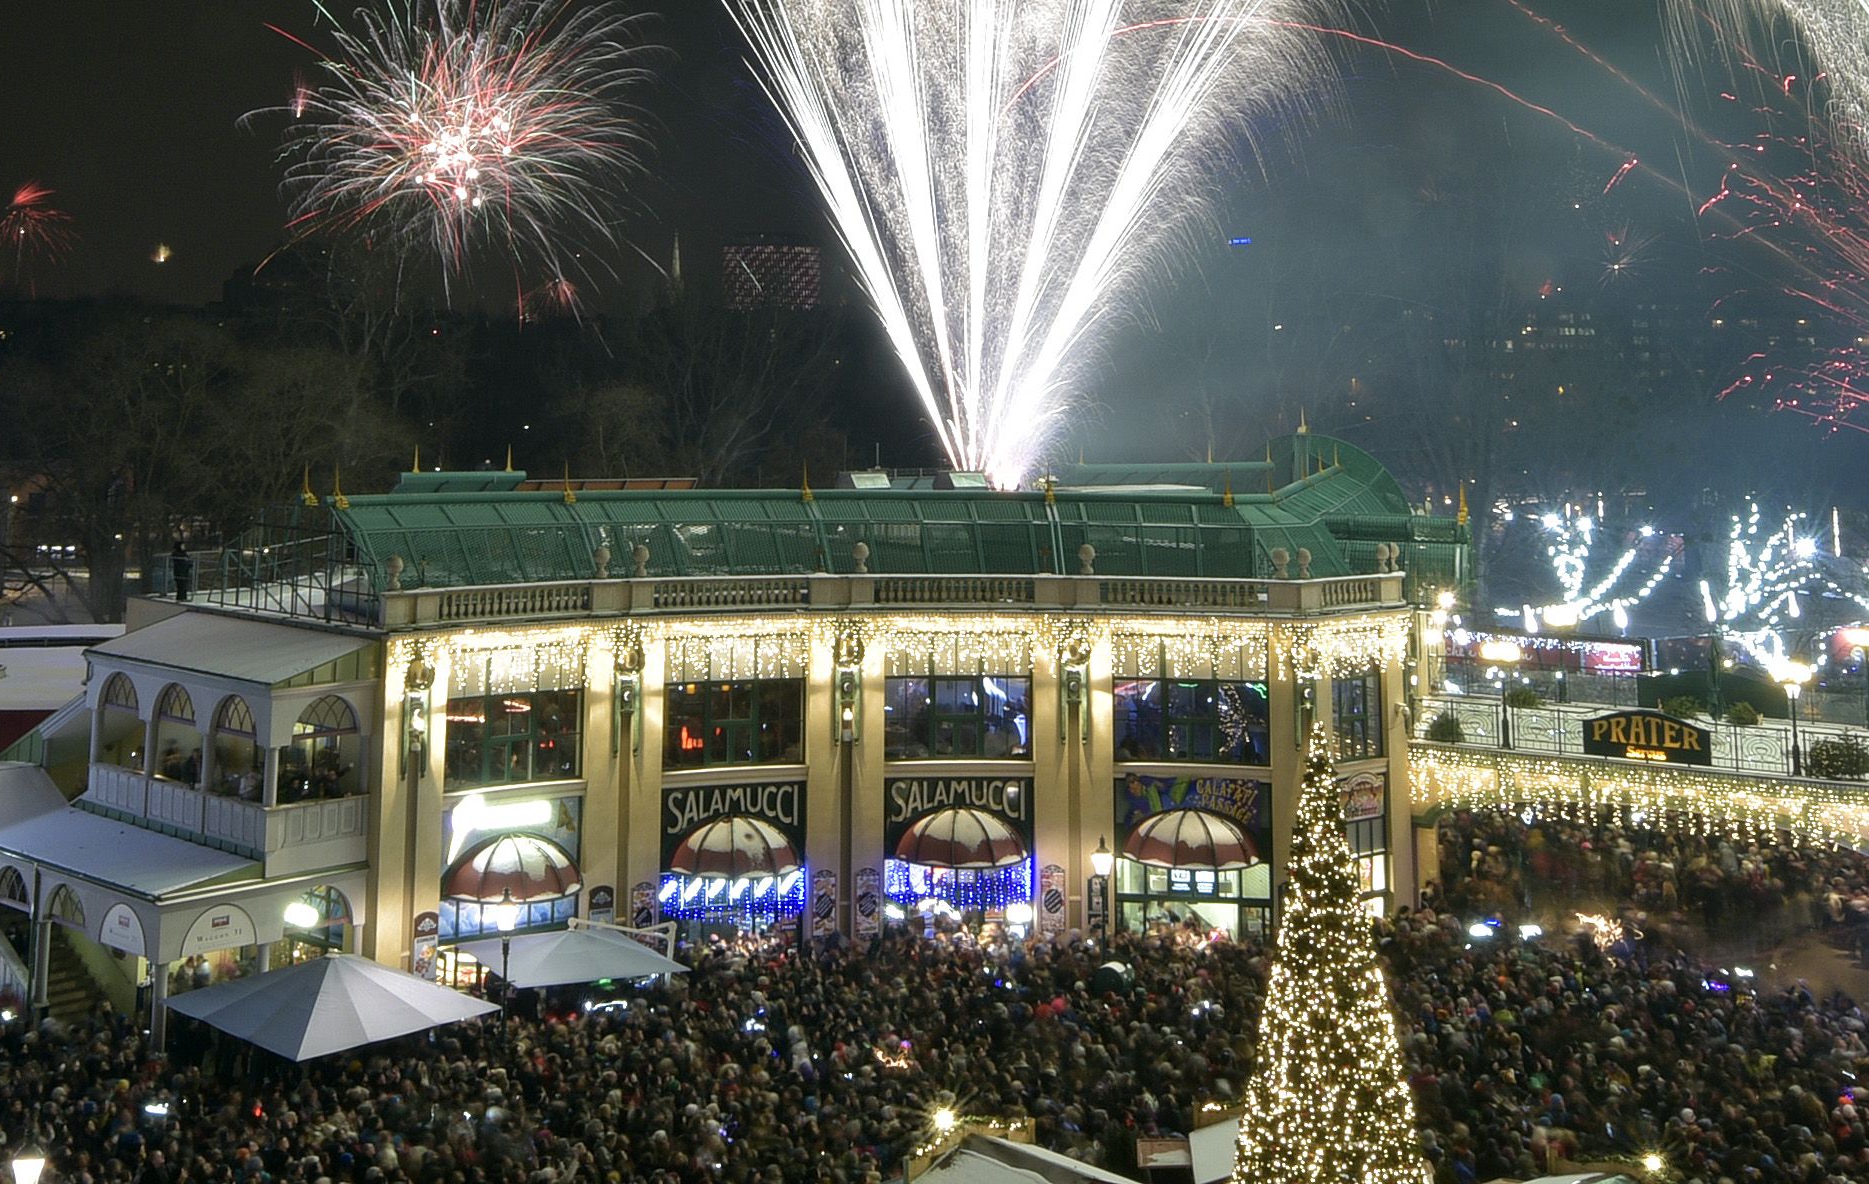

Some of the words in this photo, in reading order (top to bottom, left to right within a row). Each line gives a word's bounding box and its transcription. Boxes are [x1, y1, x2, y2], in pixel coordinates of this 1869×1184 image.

[1592, 715, 1701, 751] PRATER
[666, 784, 799, 834] SALAMUCCI
[890, 780, 1026, 822] SALAMUCCI
